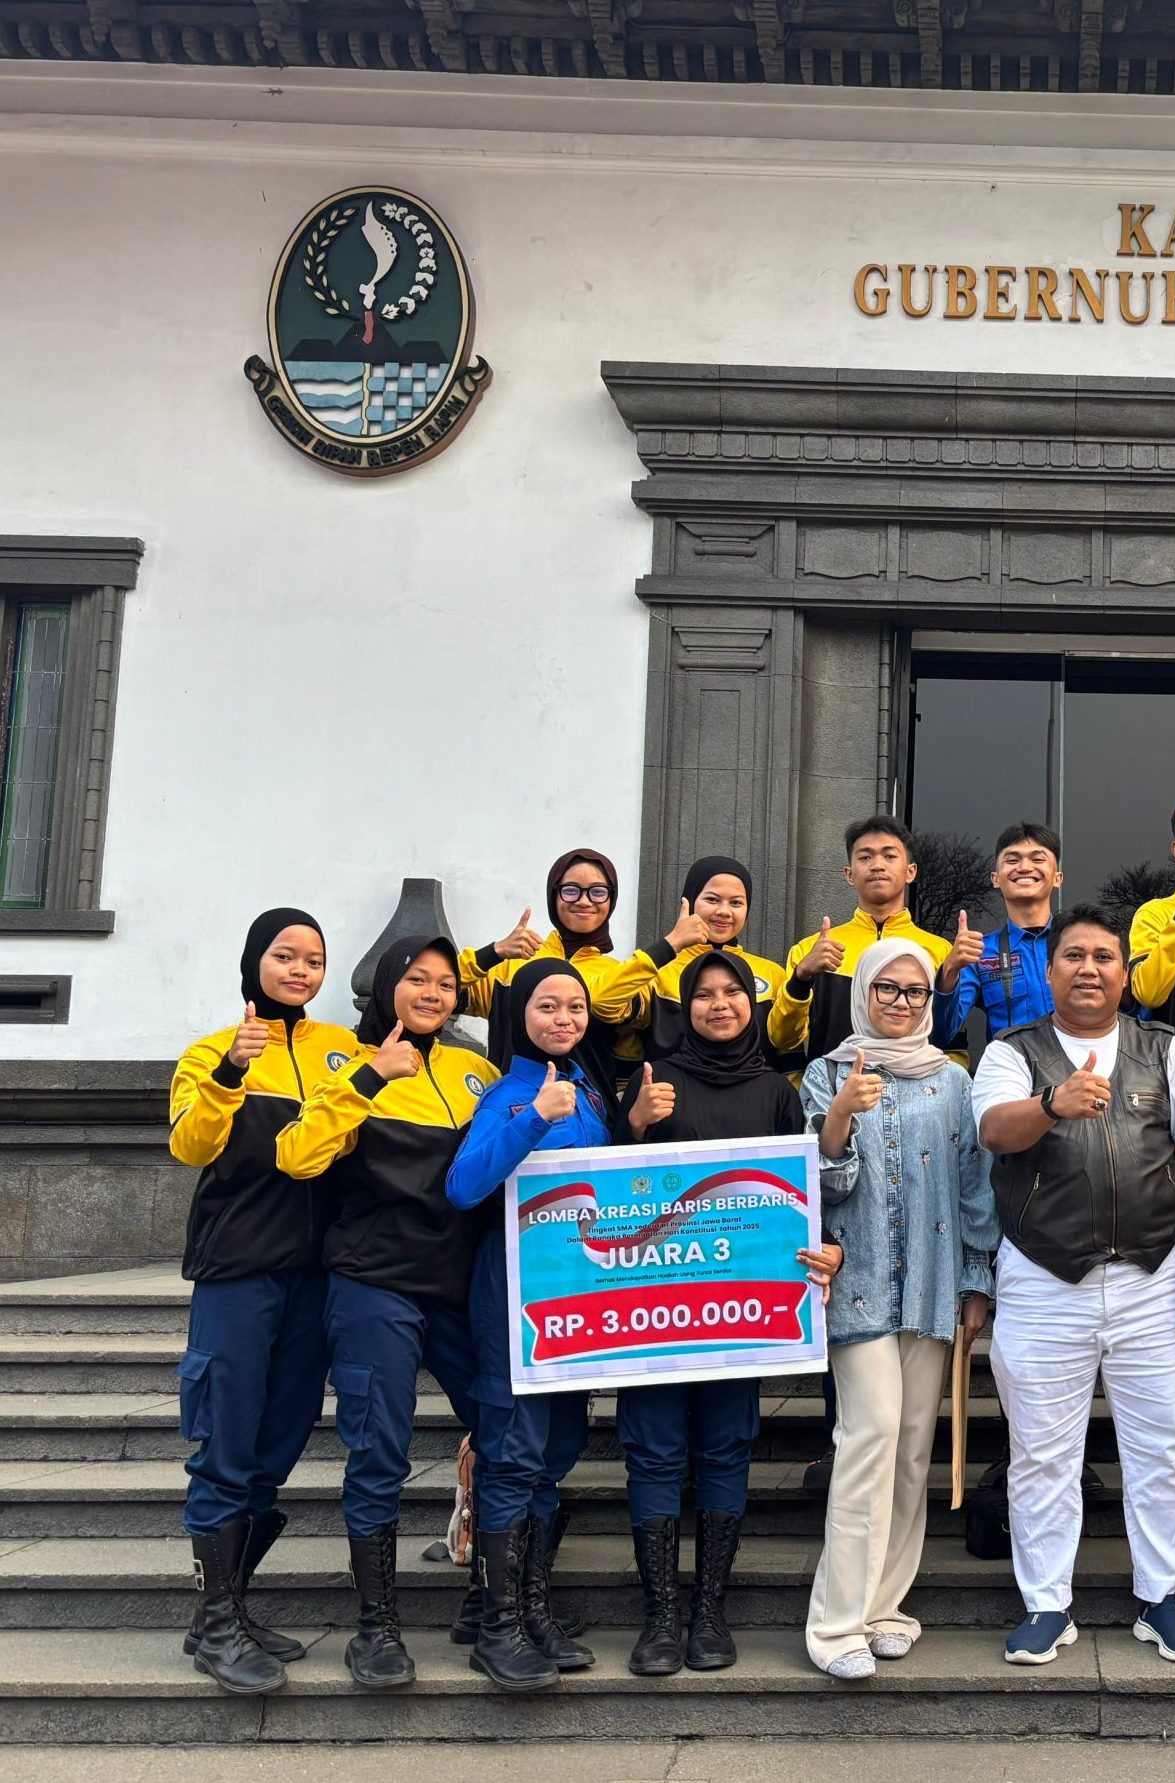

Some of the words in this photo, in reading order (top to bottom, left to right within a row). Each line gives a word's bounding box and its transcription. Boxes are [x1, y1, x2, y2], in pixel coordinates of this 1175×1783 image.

[367, 433, 425, 467] REPEH
[423, 394, 466, 442] RAPIH
[528, 1207, 591, 1225] LOMBA
[595, 1201, 656, 1221] KREASI
[661, 1198, 712, 1215] BARIS
[715, 1192, 798, 1211] BERBARIS
[588, 1227, 615, 1235] Tingkat
[592, 1234, 621, 1242] Rangka
[680, 1226, 717, 1235] Konstitusi
[600, 1244, 706, 1270] JUARA
[713, 1238, 731, 1261] 3
[544, 1313, 594, 1339] RP.
[602, 1298, 788, 1334] 3.000.000,-
